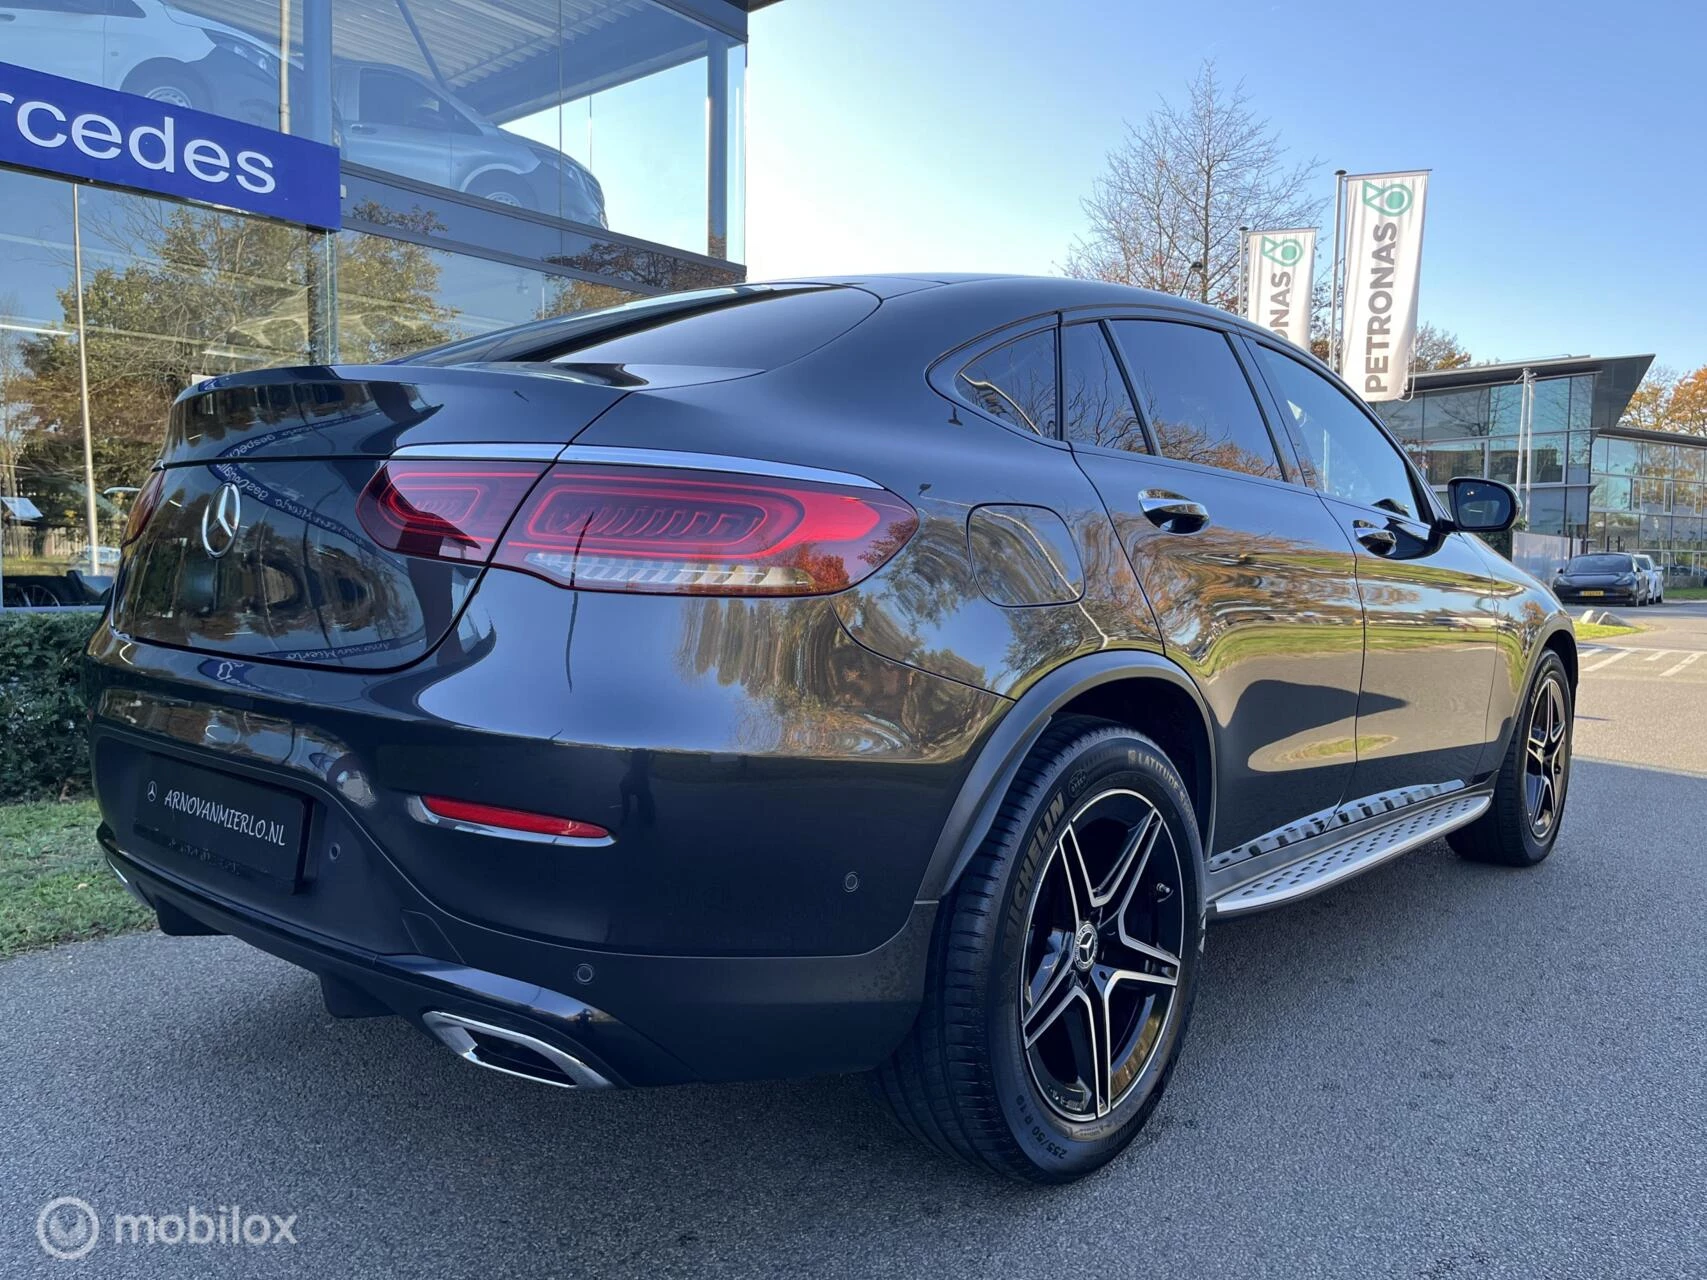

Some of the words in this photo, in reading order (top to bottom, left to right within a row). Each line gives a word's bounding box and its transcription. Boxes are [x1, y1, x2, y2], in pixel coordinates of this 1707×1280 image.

[1365, 222, 1398, 393] PETRONAS
[1138, 752, 1180, 790] LATITUDE
[164, 788, 287, 846] ARNOVANMIERLO.NL
